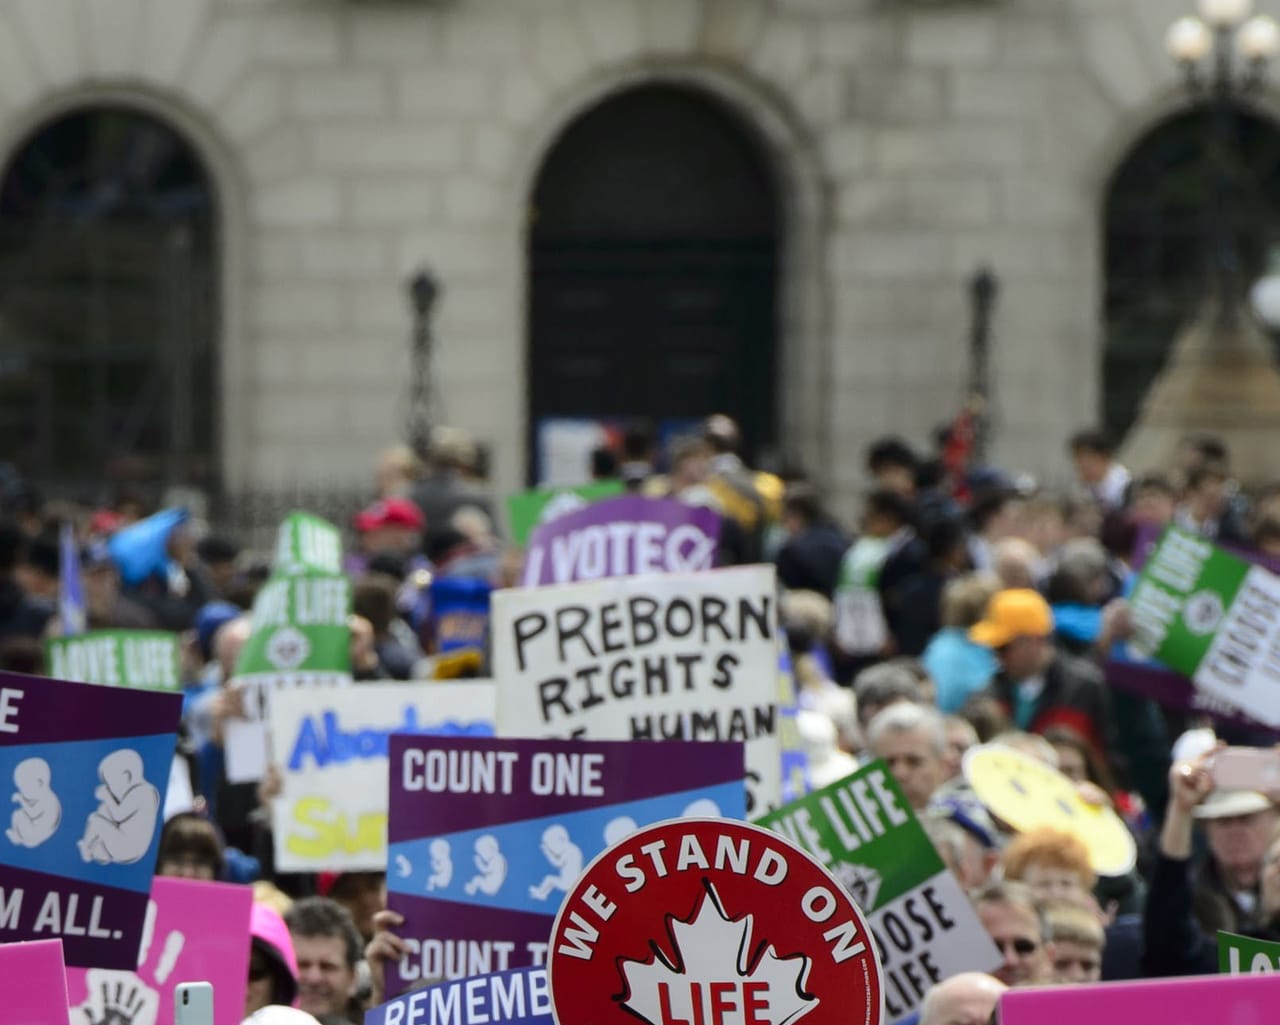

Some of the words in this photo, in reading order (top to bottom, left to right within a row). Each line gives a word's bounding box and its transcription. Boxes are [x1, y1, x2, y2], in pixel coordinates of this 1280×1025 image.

[551, 521, 667, 584] VOTE
[296, 577, 348, 625] LIFE
[512, 595, 776, 672] PREBORN
[49, 636, 119, 687] LOVE
[122, 636, 178, 688] LIFE
[537, 653, 741, 722] RIGHTS
[630, 704, 776, 742] HUMAN
[402, 748, 519, 796] COUNT
[530, 752, 606, 797] ONE
[821, 768, 909, 852] LIFE
[32, 891, 124, 940] ALL.
[558, 883, 618, 962] WE
[615, 833, 790, 894] STAND
[800, 885, 868, 965] ON
[397, 938, 516, 982] COUNT
